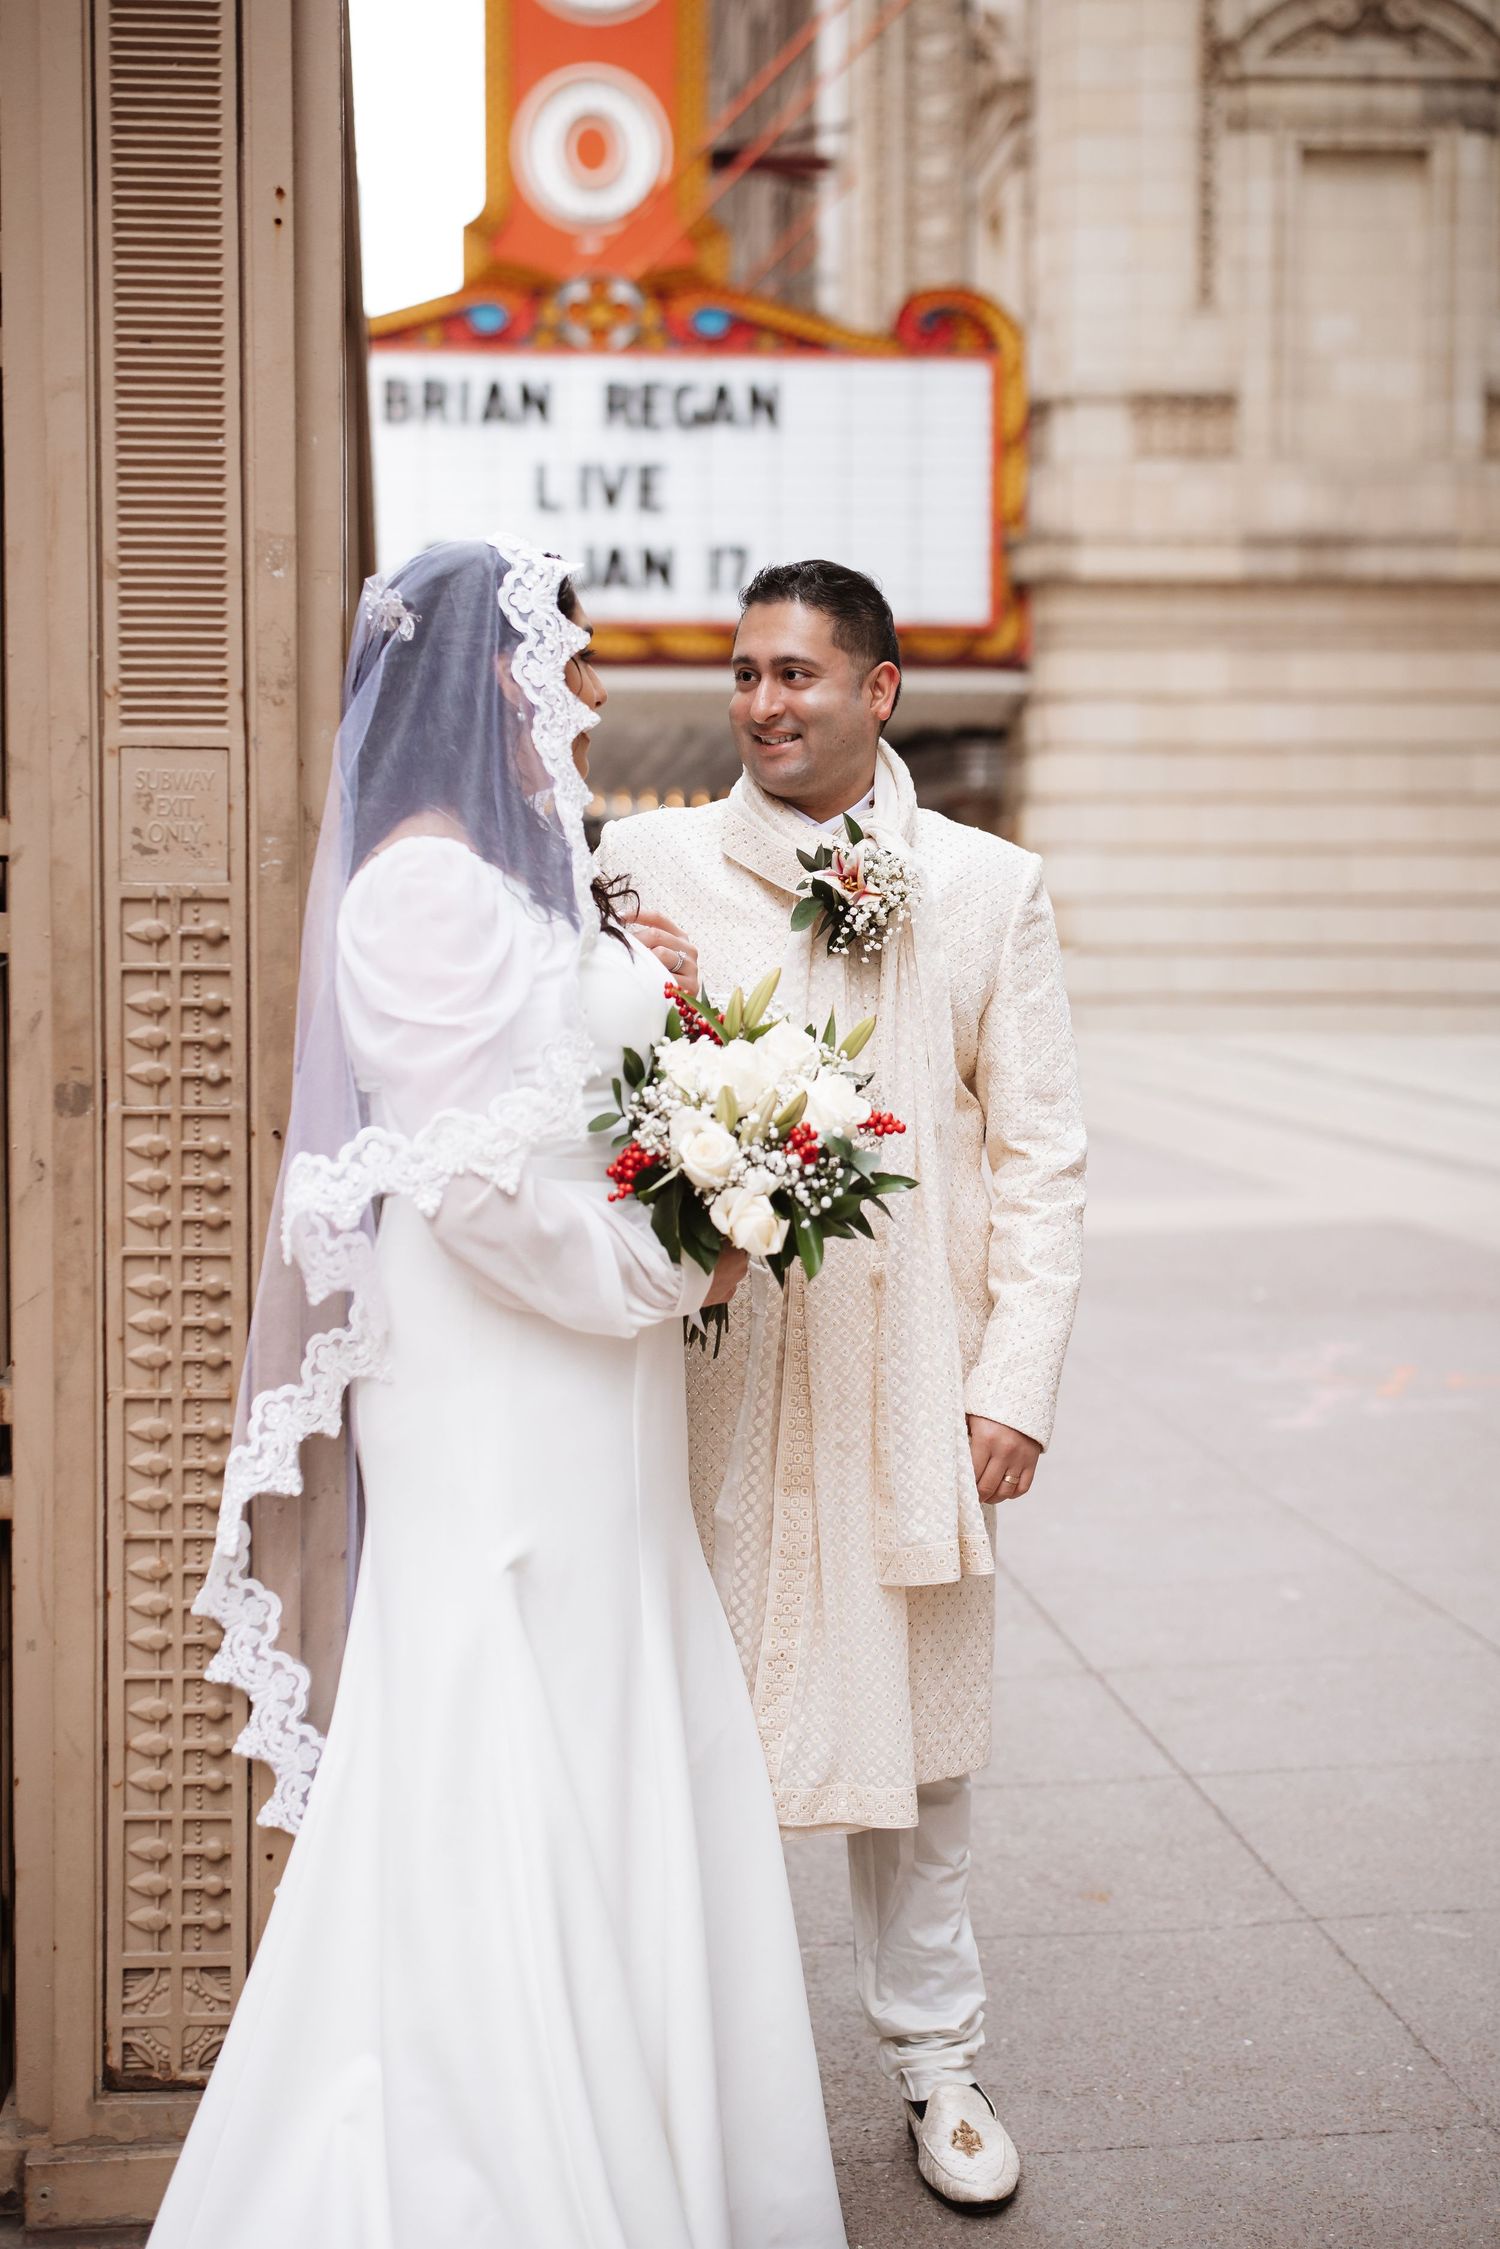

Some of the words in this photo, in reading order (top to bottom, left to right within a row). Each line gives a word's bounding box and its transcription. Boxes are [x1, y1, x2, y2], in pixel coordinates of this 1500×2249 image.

[384, 379, 550, 424] BRIAN
[606, 382, 779, 429] REGAN
[536, 464, 664, 512] LIVE
[579, 547, 674, 591] JAN
[708, 548, 748, 592] 17
[135, 768, 215, 791] SUBWAY
[156, 795, 195, 817] EXIT
[148, 820, 202, 844] ONLY
